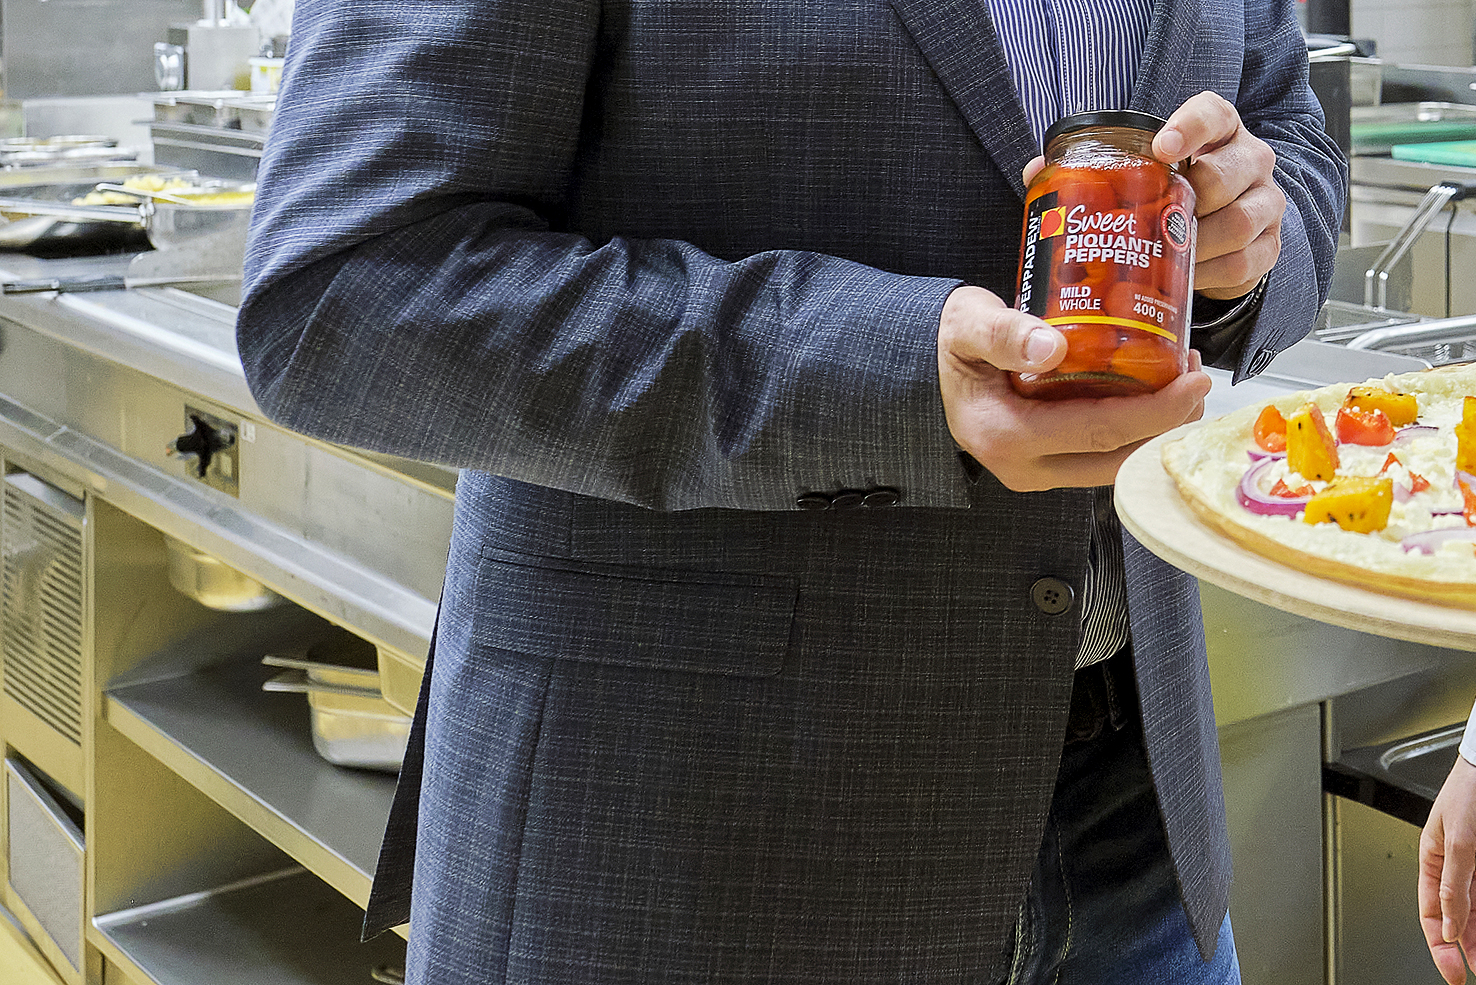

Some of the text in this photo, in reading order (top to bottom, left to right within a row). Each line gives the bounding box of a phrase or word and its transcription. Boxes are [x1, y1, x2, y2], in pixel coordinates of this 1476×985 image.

[1066, 204, 1137, 235] Sweet
[1065, 233, 1163, 258] PIQUANTÉ
[1020, 216, 1039, 313] PEPPADEW
[1064, 248, 1150, 268] PEPPERS
[1060, 286, 1092, 299] MILD
[1059, 298, 1102, 311] WHOLE
[1133, 302, 1164, 323] 400 g
